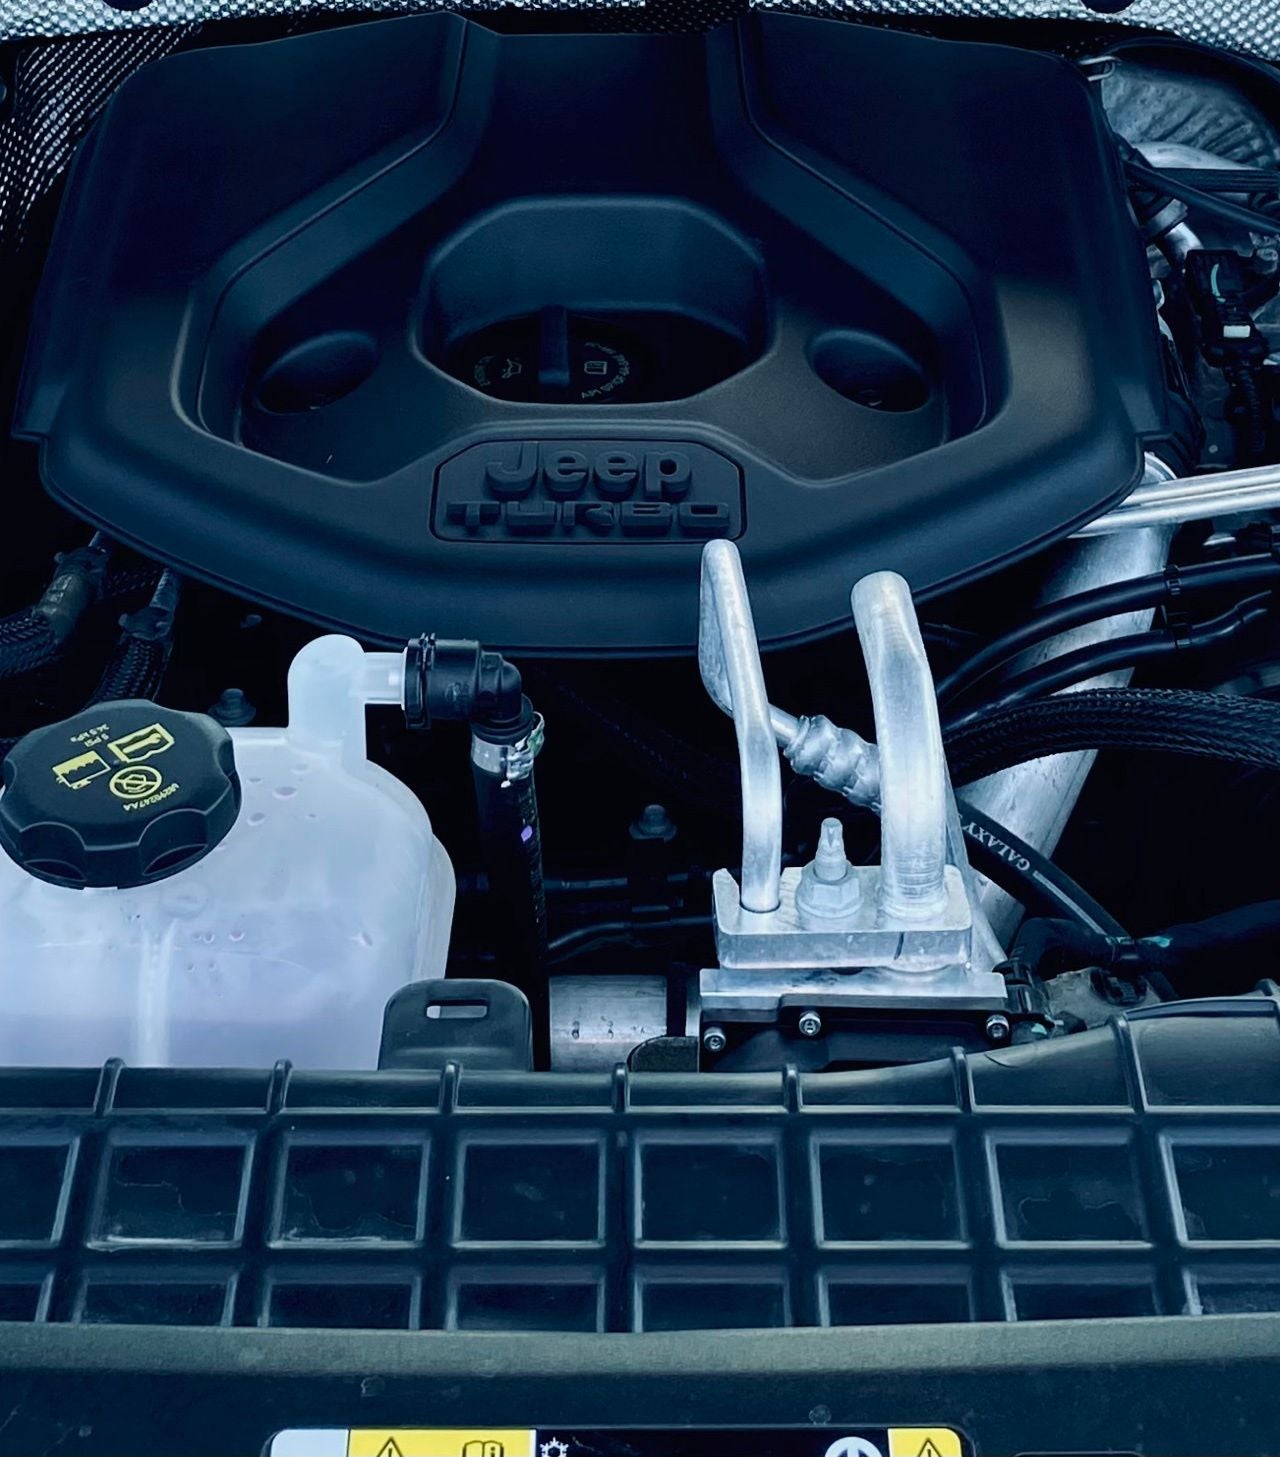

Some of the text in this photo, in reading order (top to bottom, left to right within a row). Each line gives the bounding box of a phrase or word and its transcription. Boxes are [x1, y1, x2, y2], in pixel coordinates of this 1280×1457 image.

[485, 440, 692, 498] Jeep
[445, 500, 731, 533] TURBO
[962, 819, 1032, 873] GALAXY
